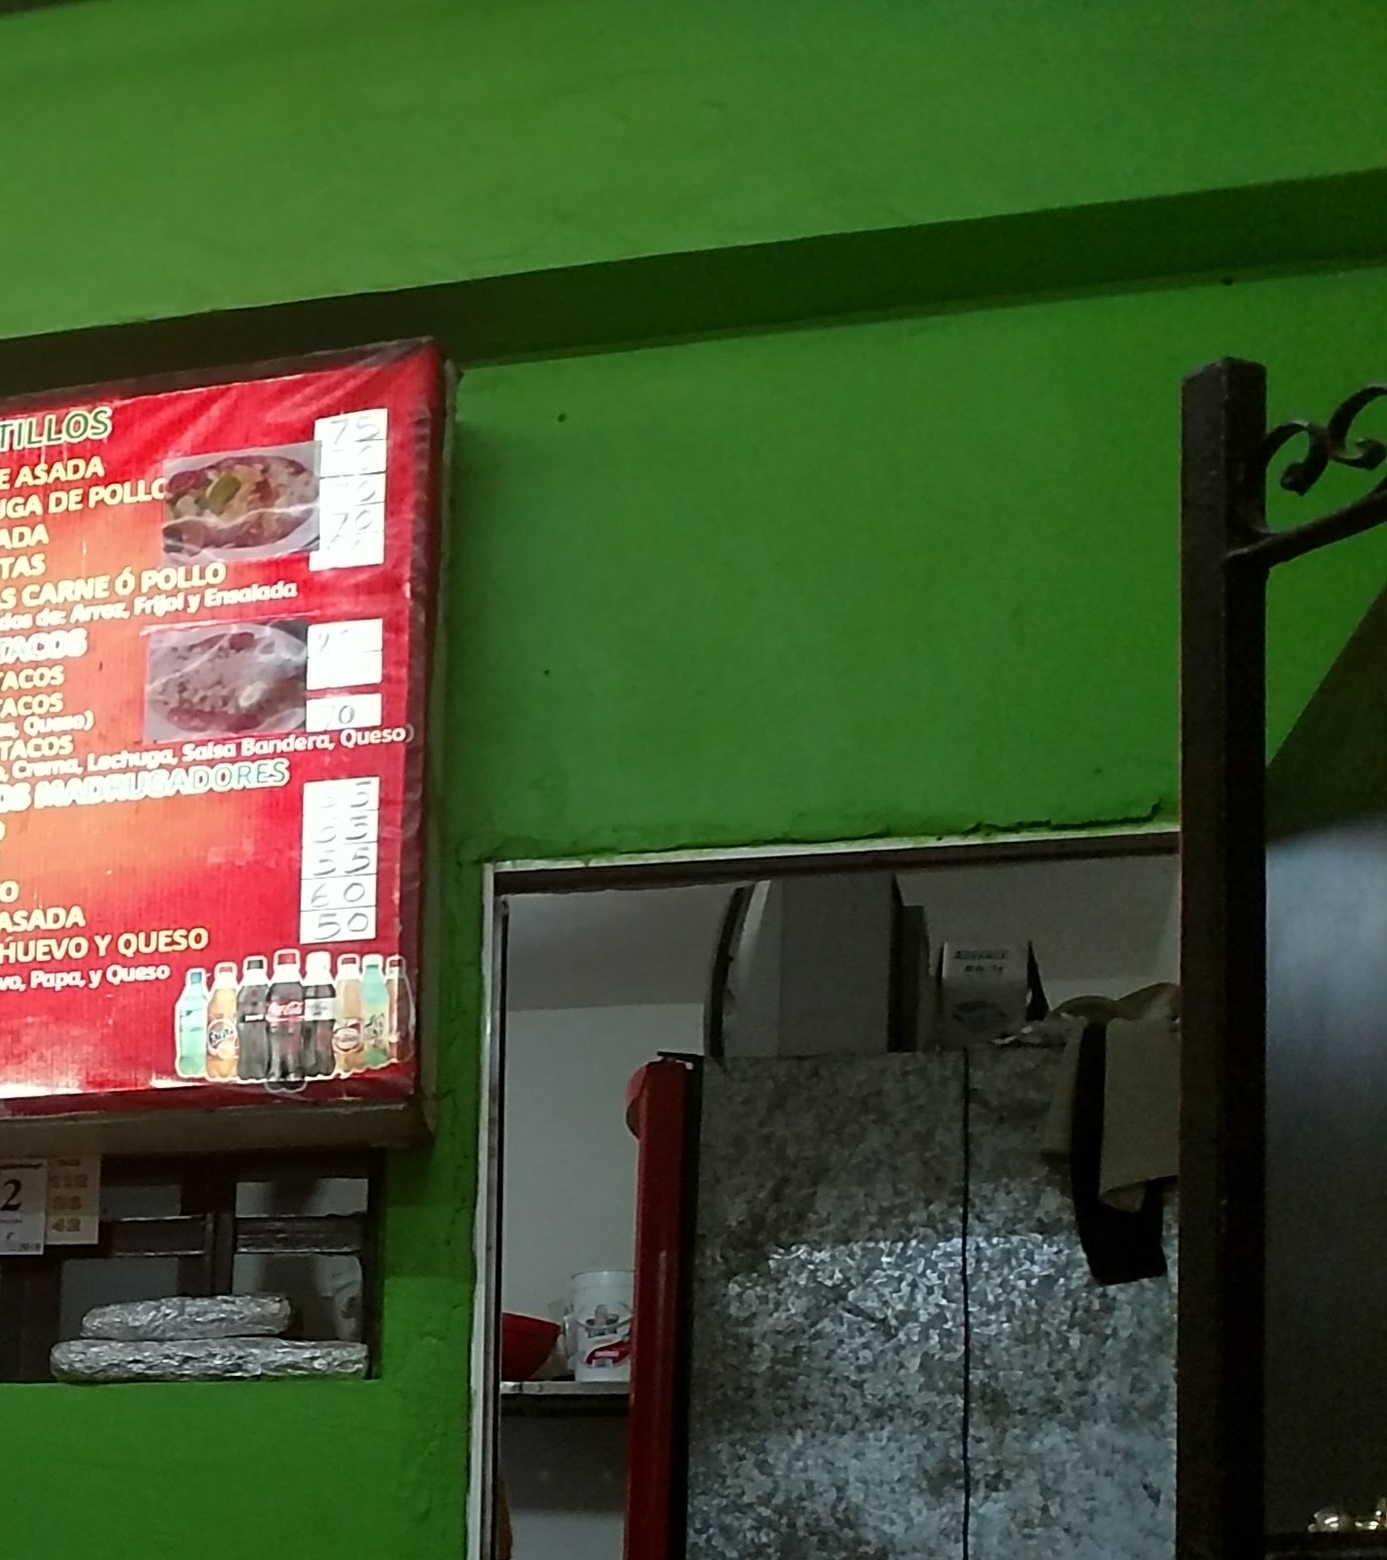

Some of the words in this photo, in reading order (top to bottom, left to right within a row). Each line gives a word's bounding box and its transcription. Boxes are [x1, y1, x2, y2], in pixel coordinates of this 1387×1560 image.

[15, 457, 105, 490] ASADA
[48, 491, 82, 515] DE
[22, 573, 109, 607] CARNE
[115, 564, 131, 595] Ó
[140, 561, 227, 594] POLLO
[314, 847, 370, 876] 55
[311, 882, 365, 908] 60
[314, 912, 369, 940] 50
[96, 934, 113, 956] Y
[117, 927, 209, 956] QUESO
[0, 1179, 22, 1211] 2
